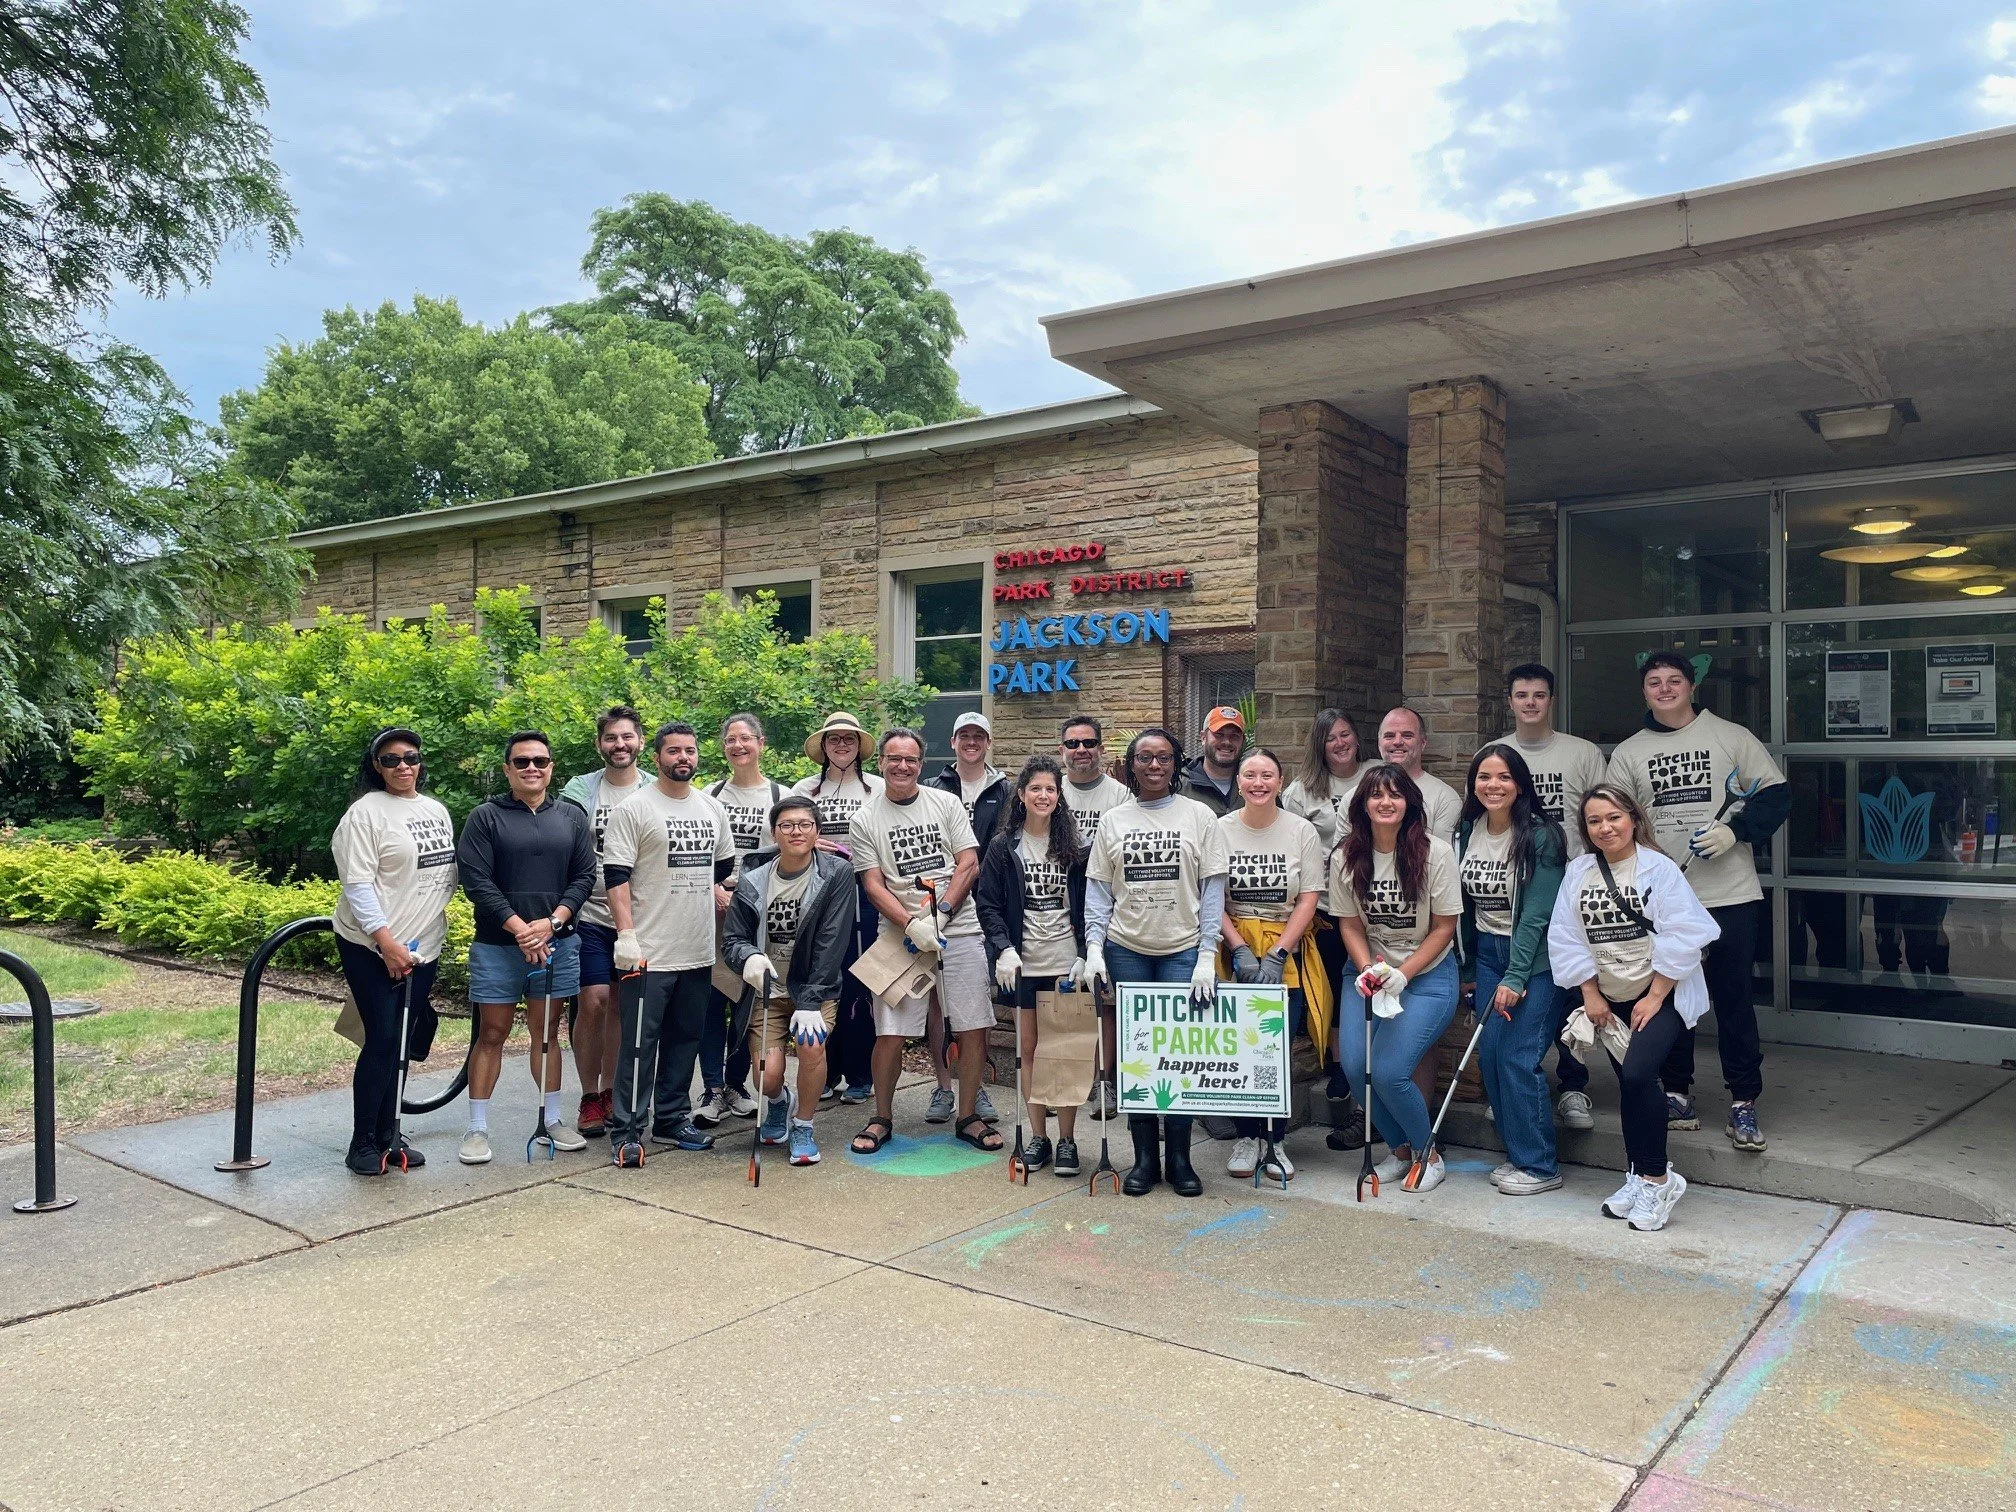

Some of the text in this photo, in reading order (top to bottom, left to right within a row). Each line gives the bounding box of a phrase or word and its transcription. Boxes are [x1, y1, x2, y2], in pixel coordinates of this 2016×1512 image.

[994, 541, 1104, 570] CHICAGO
[992, 568, 1187, 601] PARK DISTRICT
[989, 608, 1170, 652] JACKSON
[988, 659, 1080, 694] PARK
[1648, 750, 1710, 769] PITCH IN
[1649, 761, 1710, 779] FOR THE
[1548, 773, 1562, 782] IN
[1651, 772, 1711, 792] PARKS!
[1536, 784, 1563, 793] THE
[406, 820, 435, 831] PITCH
[666, 820, 698, 828] PITCH
[741, 816, 763, 824] THE
[668, 830, 714, 838] FOR THE
[730, 824, 762, 835] RKS!
[888, 823, 939, 840] PITCH IN
[412, 830, 431, 841] FOR
[1124, 831, 1162, 841] PITCH
[669, 840, 714, 851] PARKS!
[891, 833, 941, 850] FOR THE
[1123, 840, 1180, 850] FOR THE
[894, 843, 941, 861] PARKS!
[1124, 851, 1180, 864] PARKS!
[1229, 854, 1285, 864] PITCH IN
[1025, 863, 1066, 874] ITCH IN
[1229, 865, 1286, 874] FOR THE
[1464, 860, 1507, 870] PITCH IN
[1025, 873, 1066, 885] OR THE
[1462, 870, 1506, 881] FOR THE
[1229, 875, 1288, 888] PARKS!
[1371, 881, 1398, 890] TCH
[1026, 885, 1065, 896] ARKS!
[1366, 892, 1385, 902] OR
[1581, 900, 1610, 911] FOR
[768, 911, 791, 920] FOR
[1596, 950, 1612, 958] ERN
[1134, 994, 1237, 1023] PITCH IN
[1134, 1028, 1149, 1040] for
[1152, 1026, 1238, 1055] PARKS
[1136, 1042, 1148, 1052] the
[1157, 1057, 1239, 1074] happens
[1198, 1074, 1248, 1089] here!
